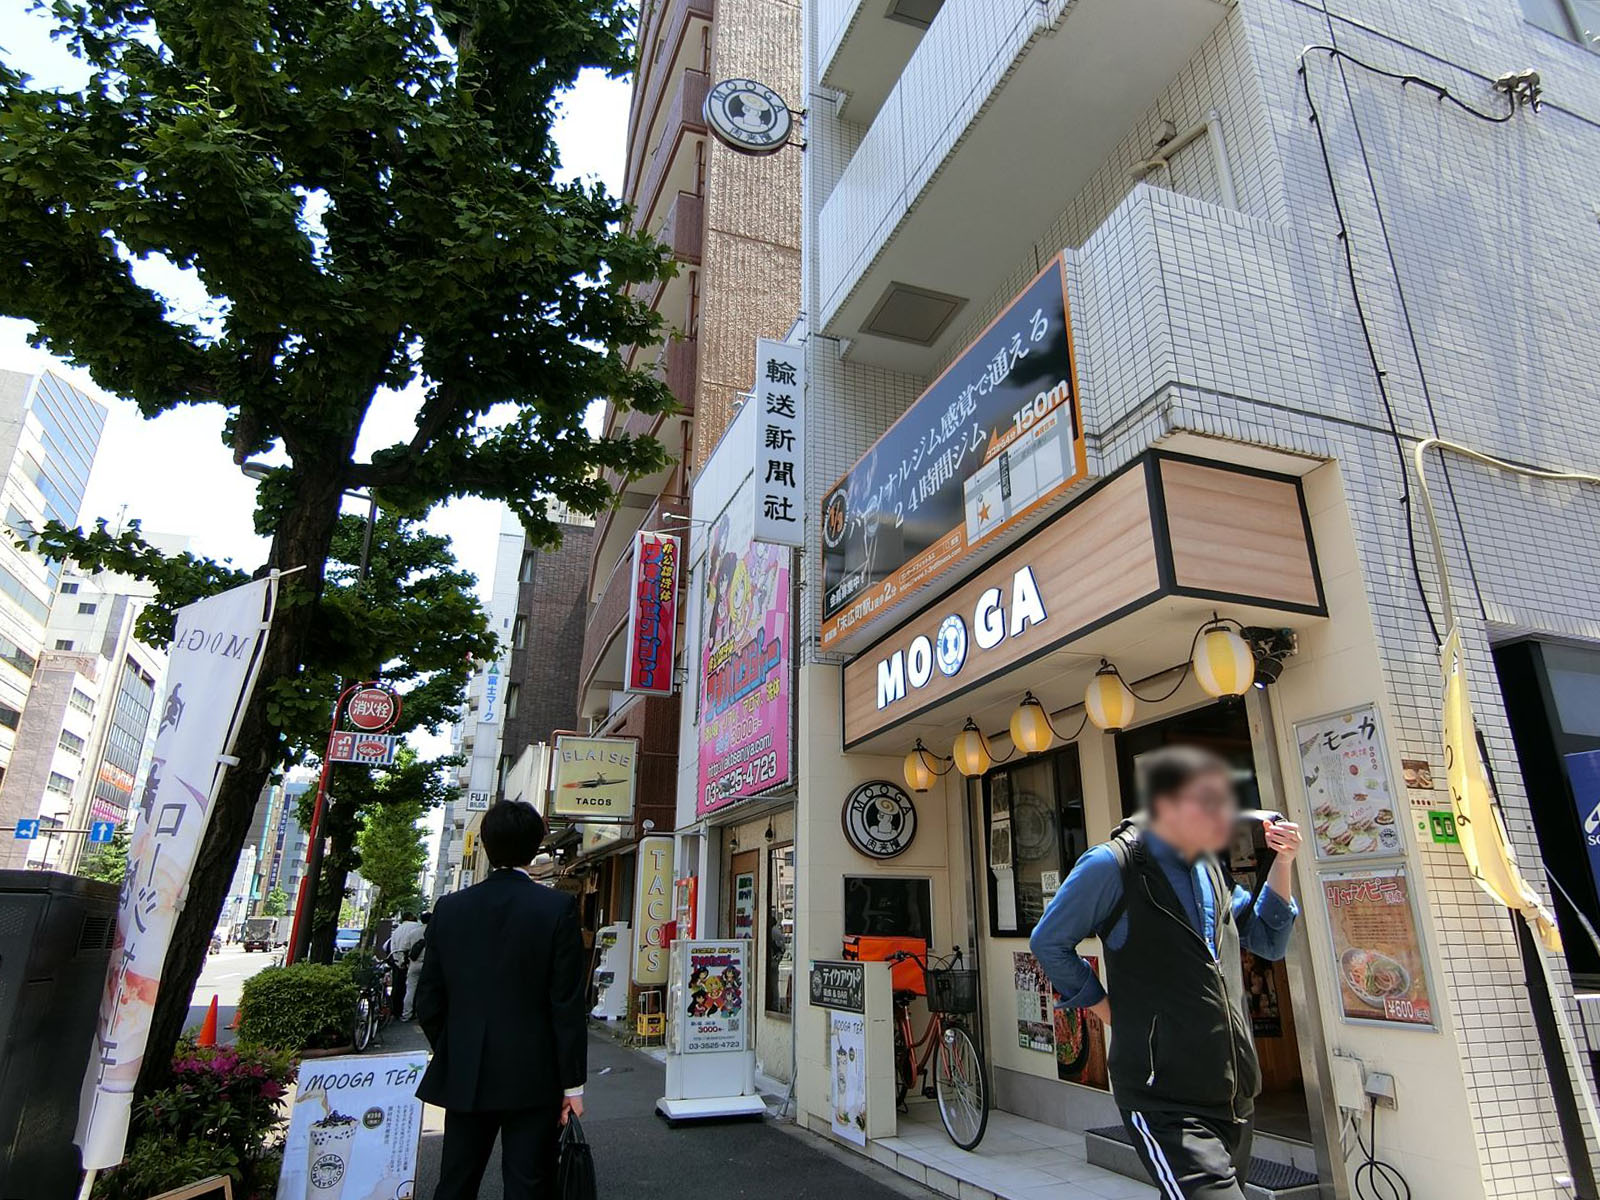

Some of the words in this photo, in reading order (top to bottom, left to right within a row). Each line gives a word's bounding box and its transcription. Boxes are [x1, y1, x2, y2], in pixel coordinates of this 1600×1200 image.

[711, 80, 786, 114] MOOGA
[1012, 379, 1069, 435] 150m
[764, 358, 797, 522] 輸送新聞社
[876, 565, 1049, 712] MOOGA
[352, 699, 390, 718] 消火栓
[484, 675, 499, 721] 富士マーク
[1323, 716, 1376, 751] モーガ
[470, 792, 488, 802] FUJI
[575, 797, 612, 807] TACOS
[852, 783, 913, 816] MOOGA
[646, 849, 666, 973] TACOS
[823, 968, 857, 989] テイクアウト
[1388, 1000, 1414, 1019] ¥600
[305, 1071, 375, 1092] MOOGA
[385, 1068, 418, 1086] TEA
